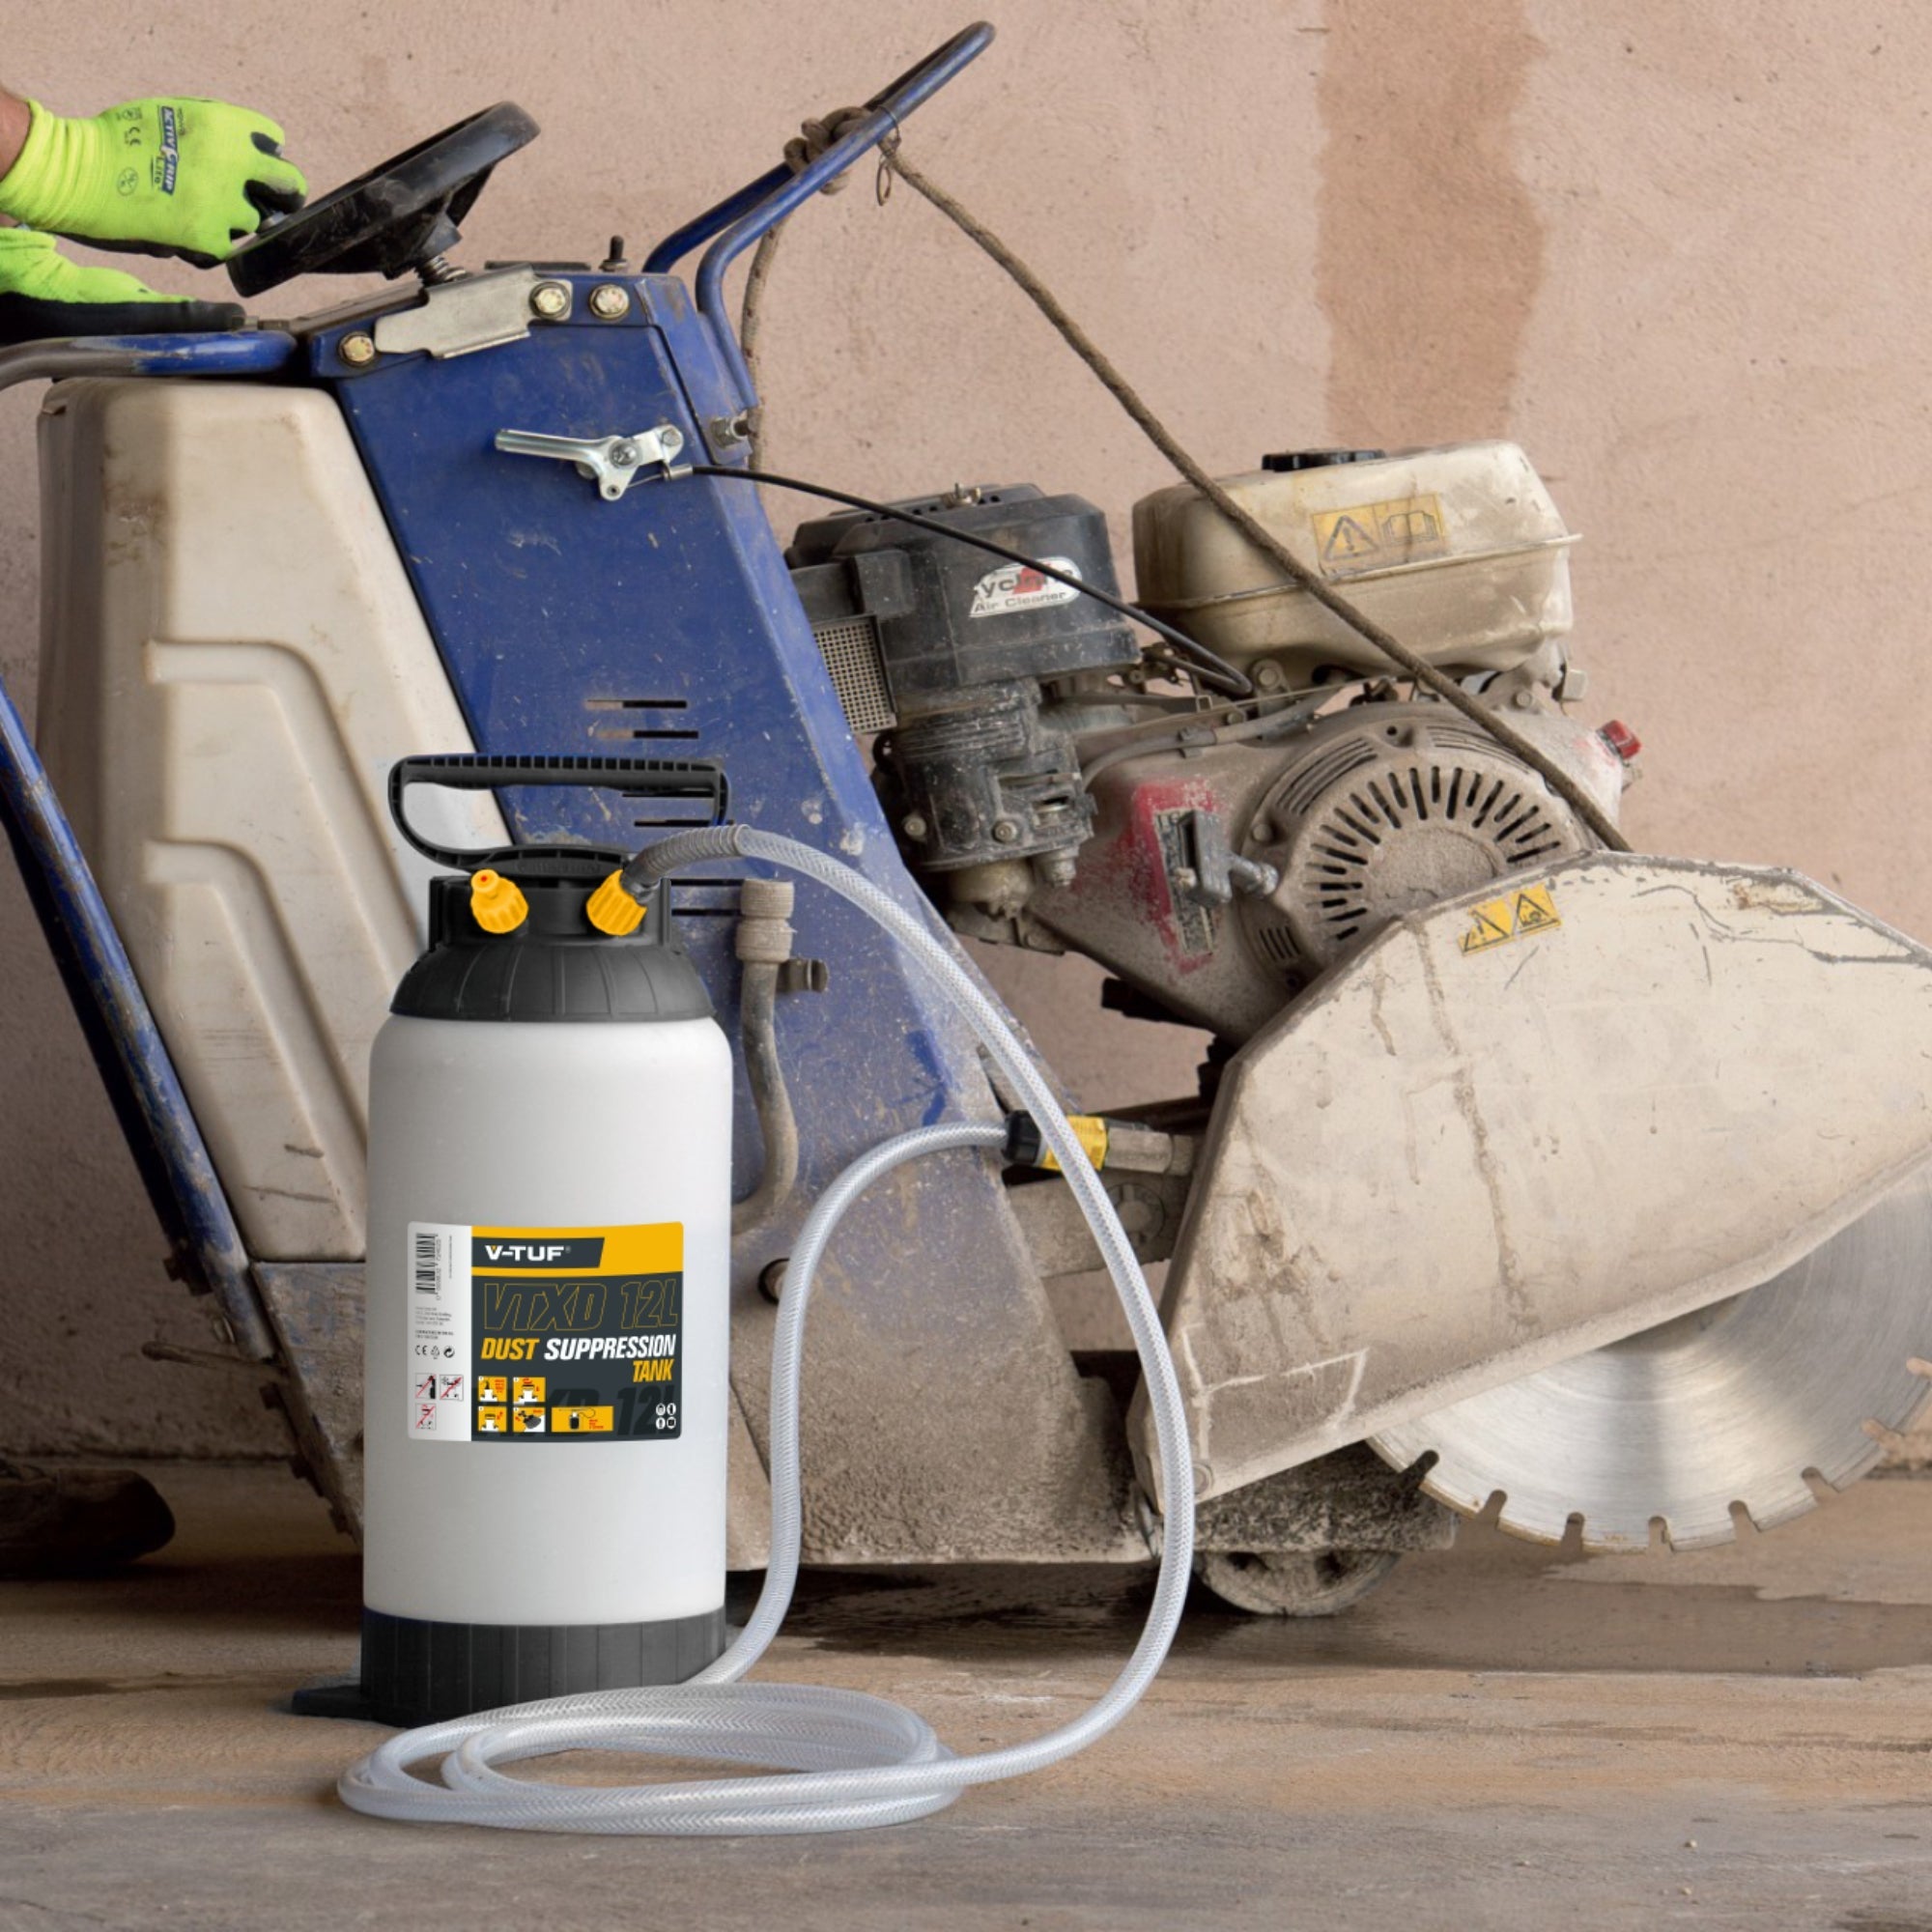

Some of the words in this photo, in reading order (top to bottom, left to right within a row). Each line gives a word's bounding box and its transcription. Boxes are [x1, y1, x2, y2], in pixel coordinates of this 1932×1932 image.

[975, 601, 999, 612] Air
[1005, 591, 1066, 608] Cleaner
[485, 1244, 565, 1262] V-TUF
[484, 1283, 608, 1331] VTXD
[620, 1278, 678, 1330] 12L
[481, 1338, 540, 1360] DUST
[544, 1334, 676, 1361] SUPPRESSION
[633, 1359, 673, 1382] TANK
